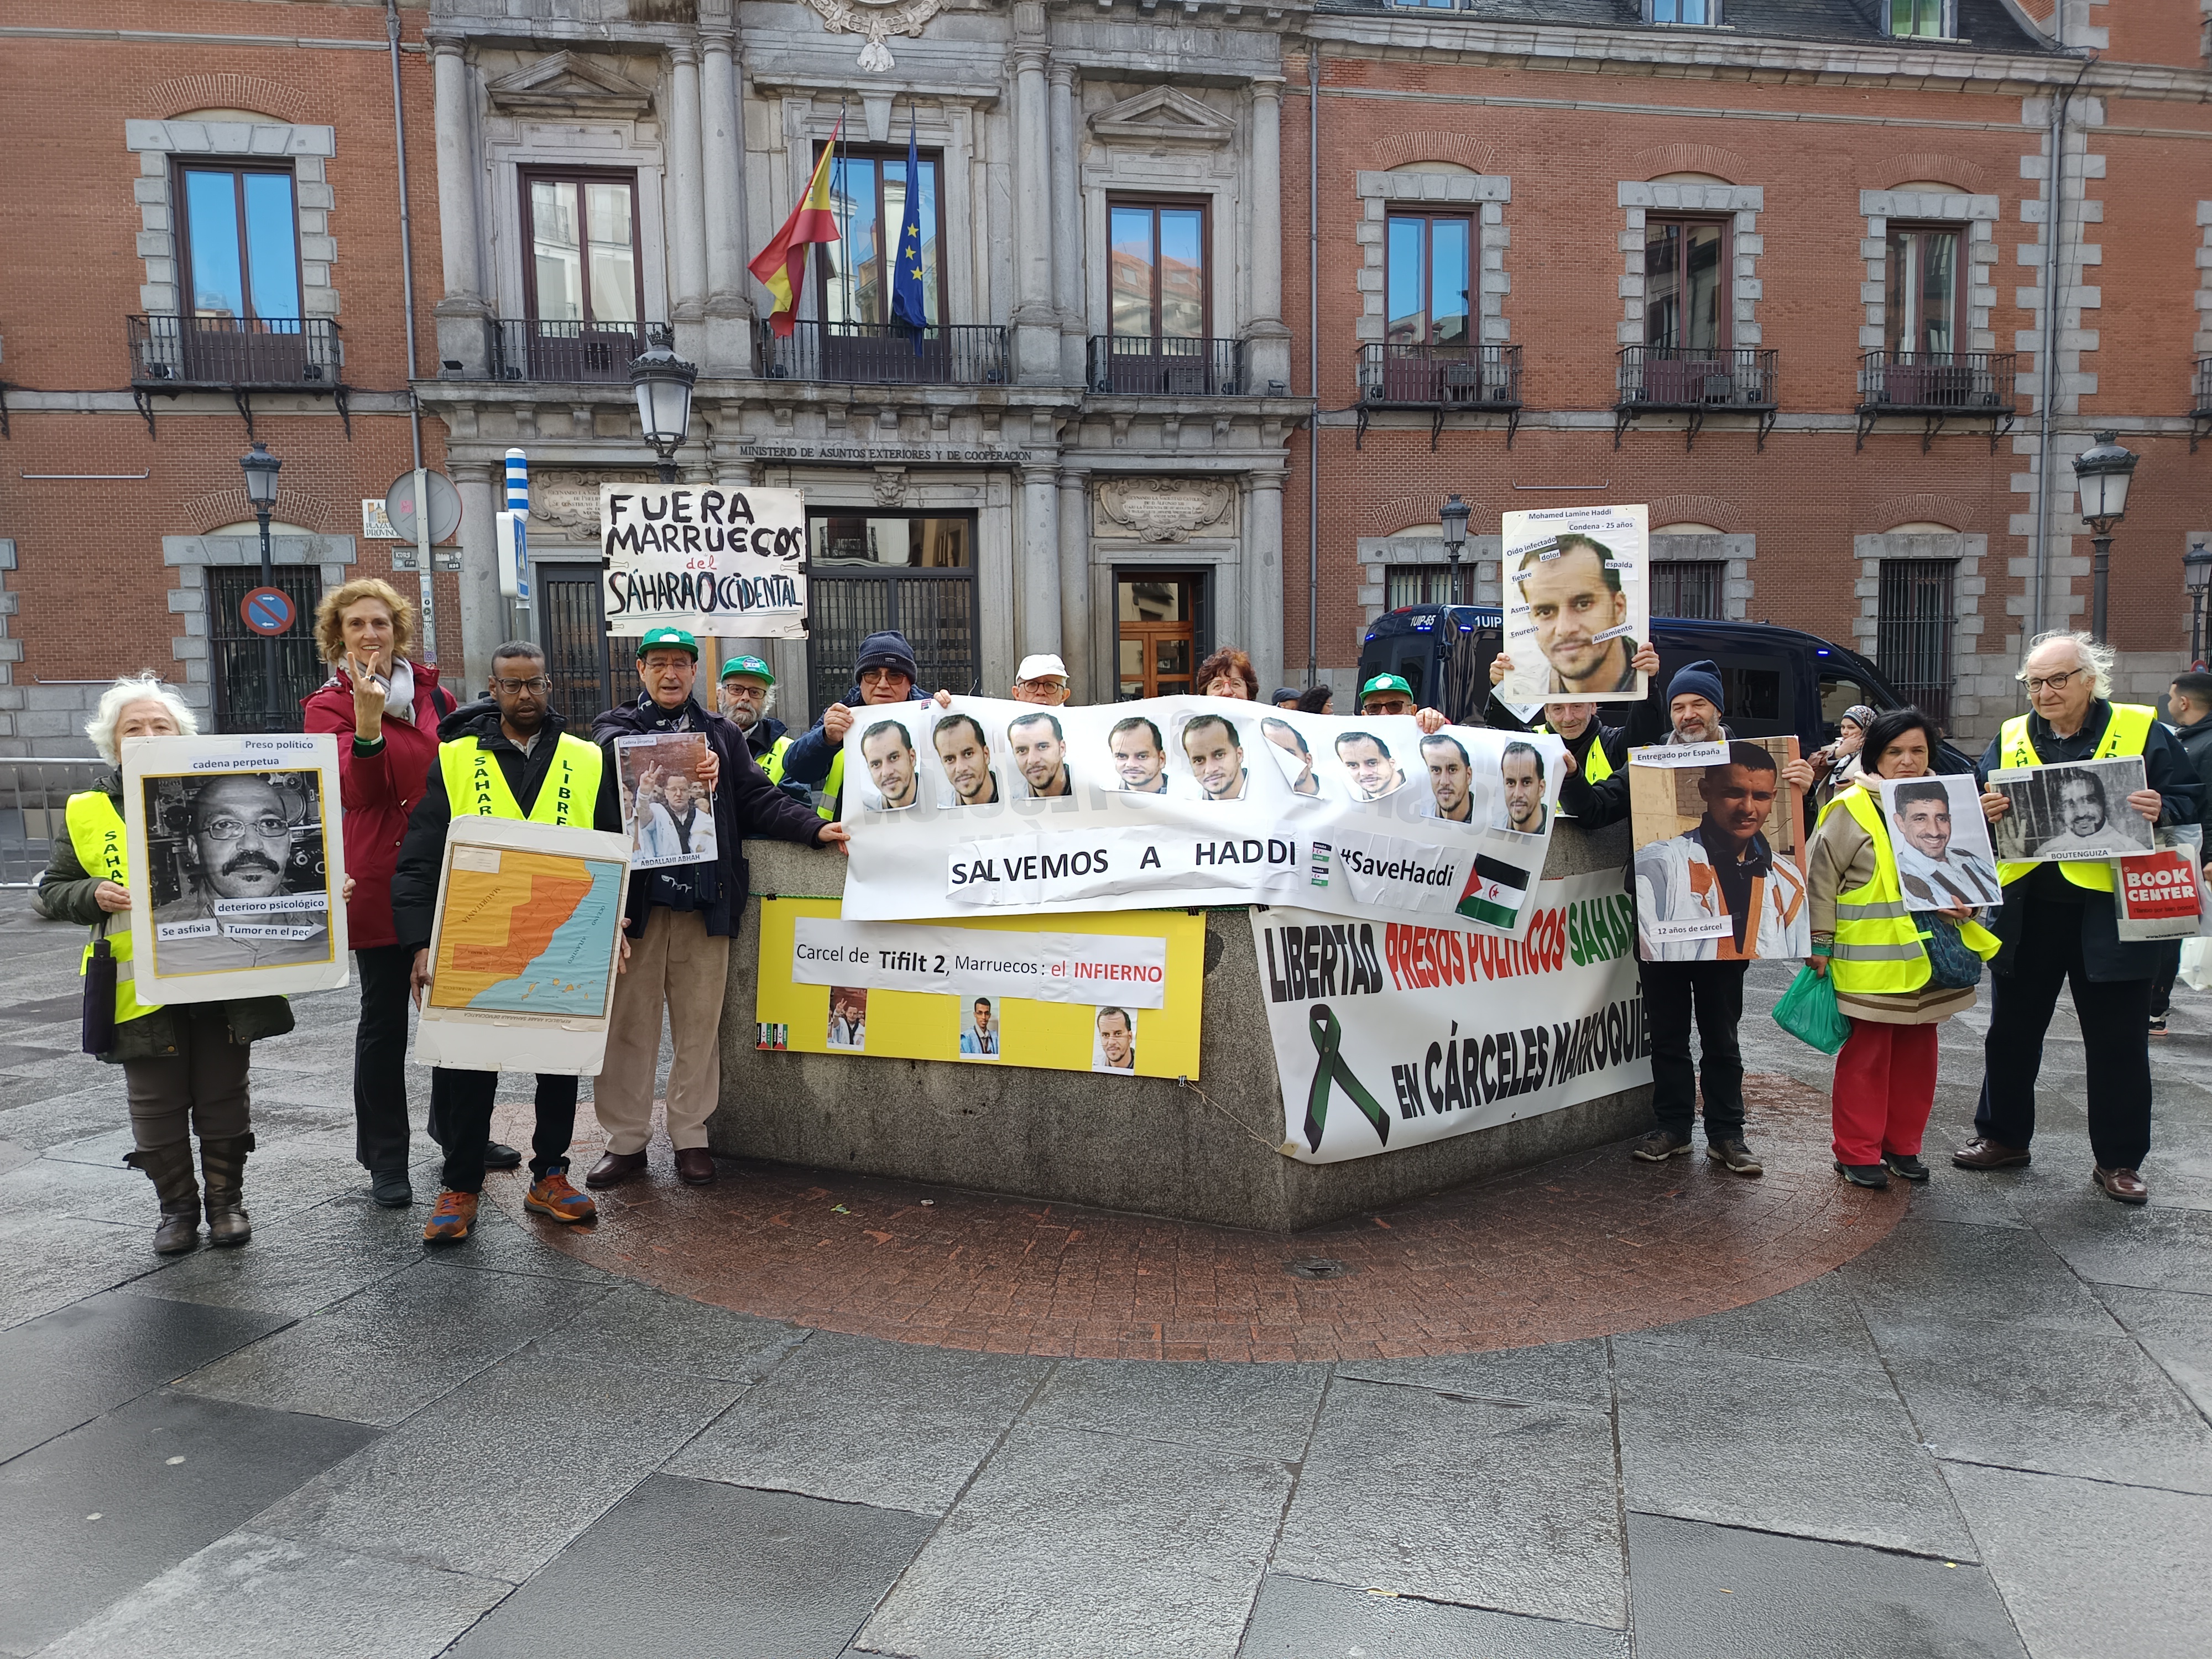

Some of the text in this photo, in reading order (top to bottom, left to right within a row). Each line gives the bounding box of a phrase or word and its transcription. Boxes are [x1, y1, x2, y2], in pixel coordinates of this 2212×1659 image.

[740, 446, 1032, 461] MINISTERIO DE ASUNTOS EXTERIORES Y DE COOPERACION
[611, 491, 754, 526] FUERA
[1528, 512, 1564, 520] Mohamed
[606, 523, 802, 561] MARRUECOS
[1507, 536, 1557, 556] Oído infectado
[686, 555, 717, 570] del
[1541, 551, 1559, 561] dolor
[1512, 571, 1532, 582] fiebre
[1511, 605, 1530, 614] Asma
[1410, 615, 1436, 627] 1UIP-65
[1474, 615, 1504, 628] 1UIP
[1511, 625, 1539, 638] Enuresis
[1594, 624, 1633, 642] Aislamiento
[245, 740, 314, 751] Preso político
[763, 748, 776, 775] LIB
[1637, 752, 1676, 761] Entregado
[1693, 749, 1720, 758] España
[193, 758, 279, 769] cadena perpetua
[474, 757, 492, 816] SAHAR
[103, 831, 124, 886] SAHA
[641, 854, 700, 867] ABDALLAHI ABHAH
[951, 839, 1296, 884] SALVEMOS A HADDI
[2051, 850, 2108, 859] BOUTENGUIZA
[1340, 848, 1454, 886] #SaveHaddi
[2127, 868, 2191, 887] BOOK
[2128, 885, 2195, 902] CENTER
[218, 898, 324, 912] deterioro psicológico
[462, 886, 501, 923] MAURITANIA
[162, 924, 211, 936] Se asfixia
[229, 926, 262, 935] Tumor
[279, 926, 289, 936] el
[292, 929, 309, 937] pec
[1668, 925, 1687, 933] años
[1265, 924, 1383, 1003] LIBERTAD
[1385, 922, 1465, 990] PRESOS
[1569, 894, 1635, 967] SAHAR
[797, 944, 843, 962] Carcel
[849, 947, 869, 963] de
[879, 951, 927, 972] Tifilt
[1051, 960, 1066, 977] el
[1074, 962, 1162, 983] INFIERNO
[1391, 980, 1652, 1119] EN CÁRCELES MARROQUÍE
